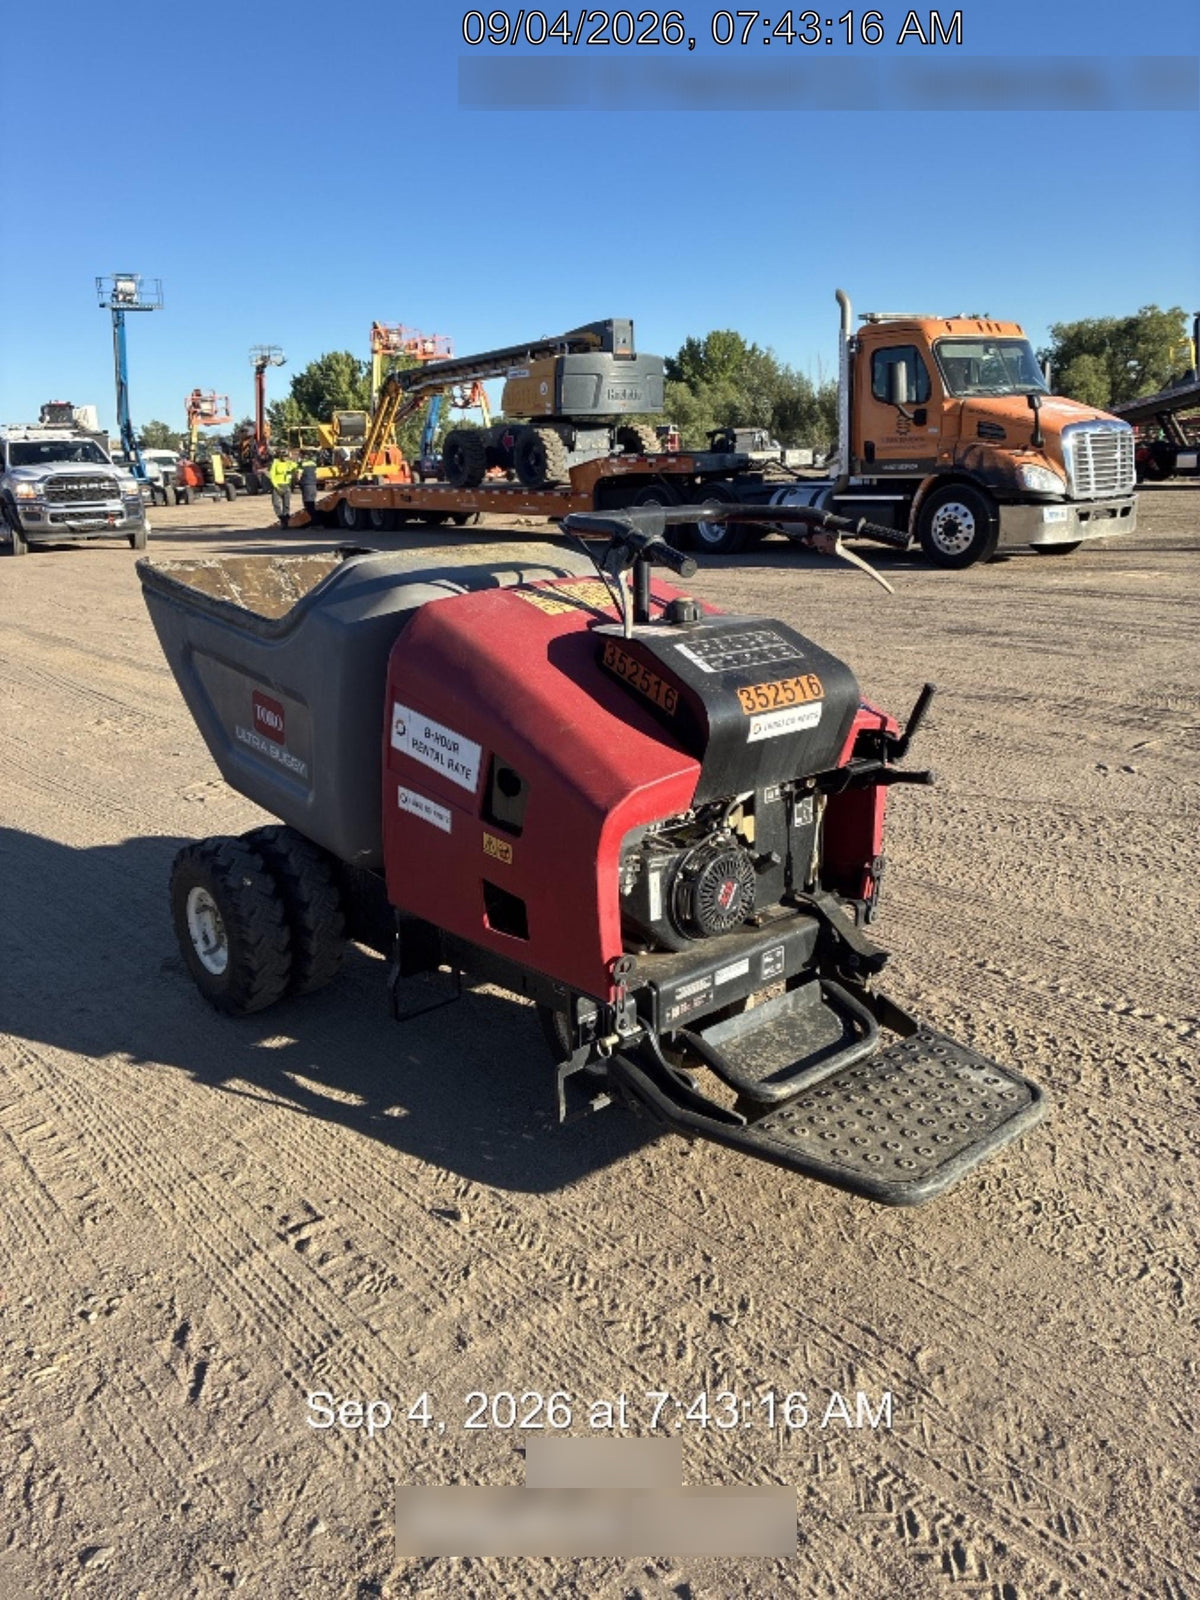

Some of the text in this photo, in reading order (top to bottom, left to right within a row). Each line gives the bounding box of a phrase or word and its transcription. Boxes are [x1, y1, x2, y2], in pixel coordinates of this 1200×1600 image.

[604, 643, 677, 711] 352516
[739, 676, 823, 711] 352516
[412, 737, 472, 781] RENTAL RATE
[424, 726, 460, 754] 8-HOUR
